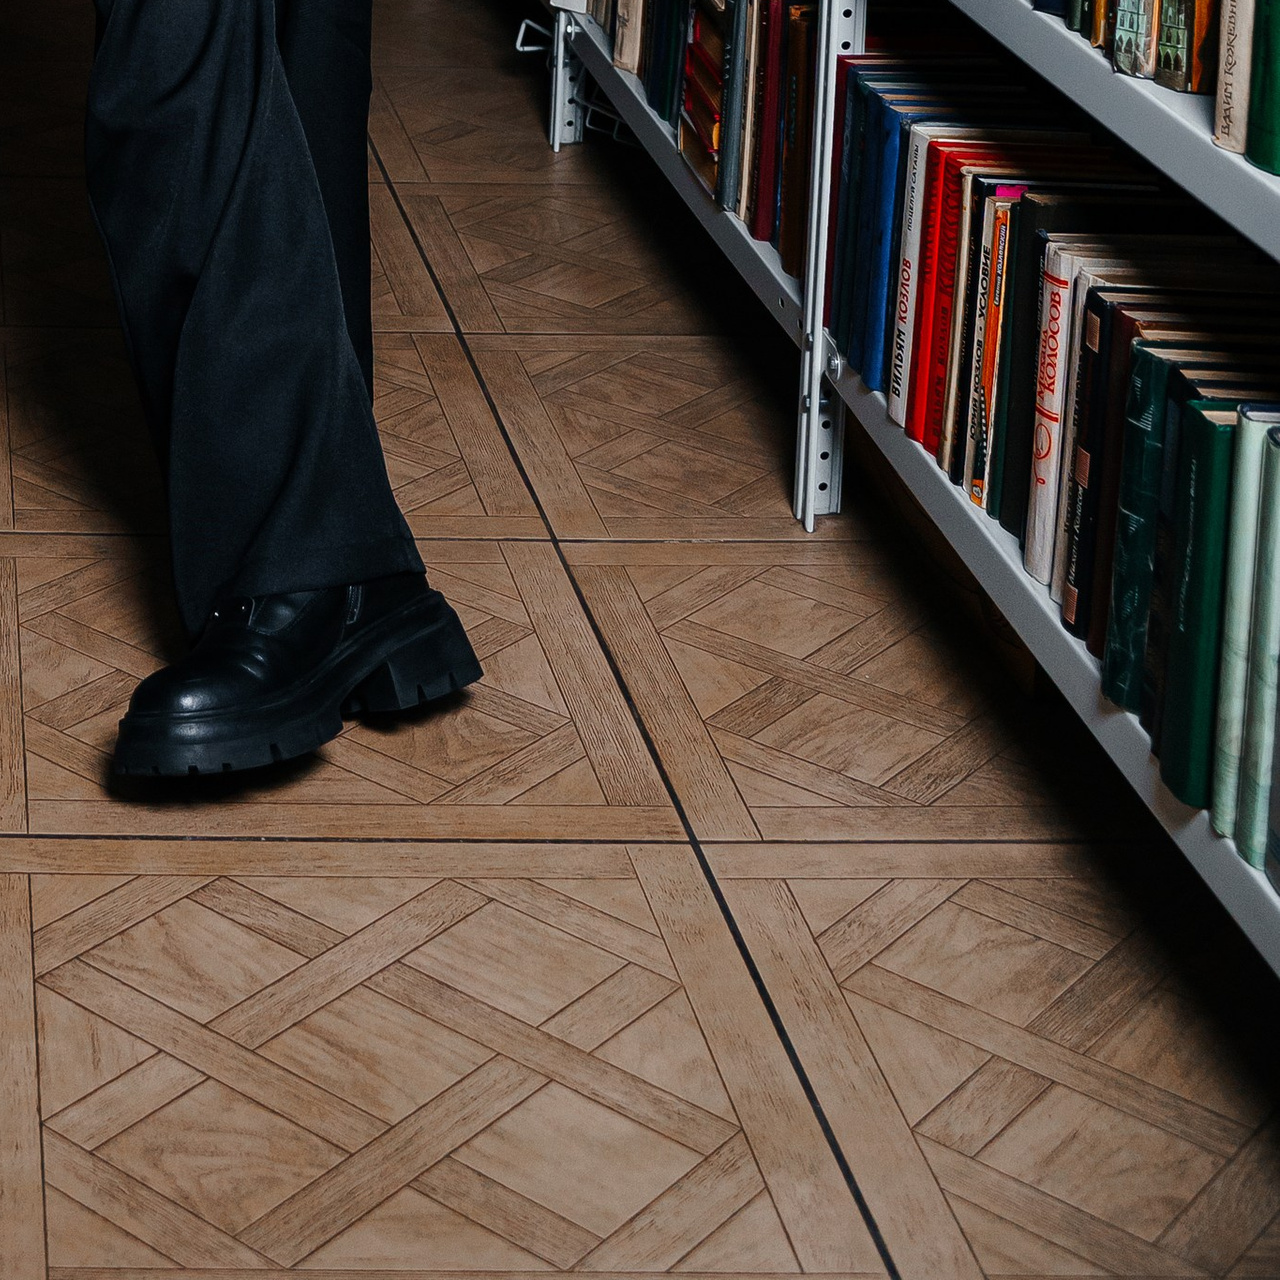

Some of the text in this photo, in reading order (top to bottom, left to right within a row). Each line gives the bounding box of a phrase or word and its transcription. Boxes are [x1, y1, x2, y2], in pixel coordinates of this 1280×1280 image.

[891, 144, 920, 399] ВИЛЬЯМ КОЗЛОВ ПОЦЕЛУЙ САТАНЫ
[968, 244, 992, 442] ЮРИЙ КОЗЛОВ УСЛОВИЕ
[1043, 290, 1062, 394] КОЛОСОВ
[1035, 328, 1048, 401] Михаил
